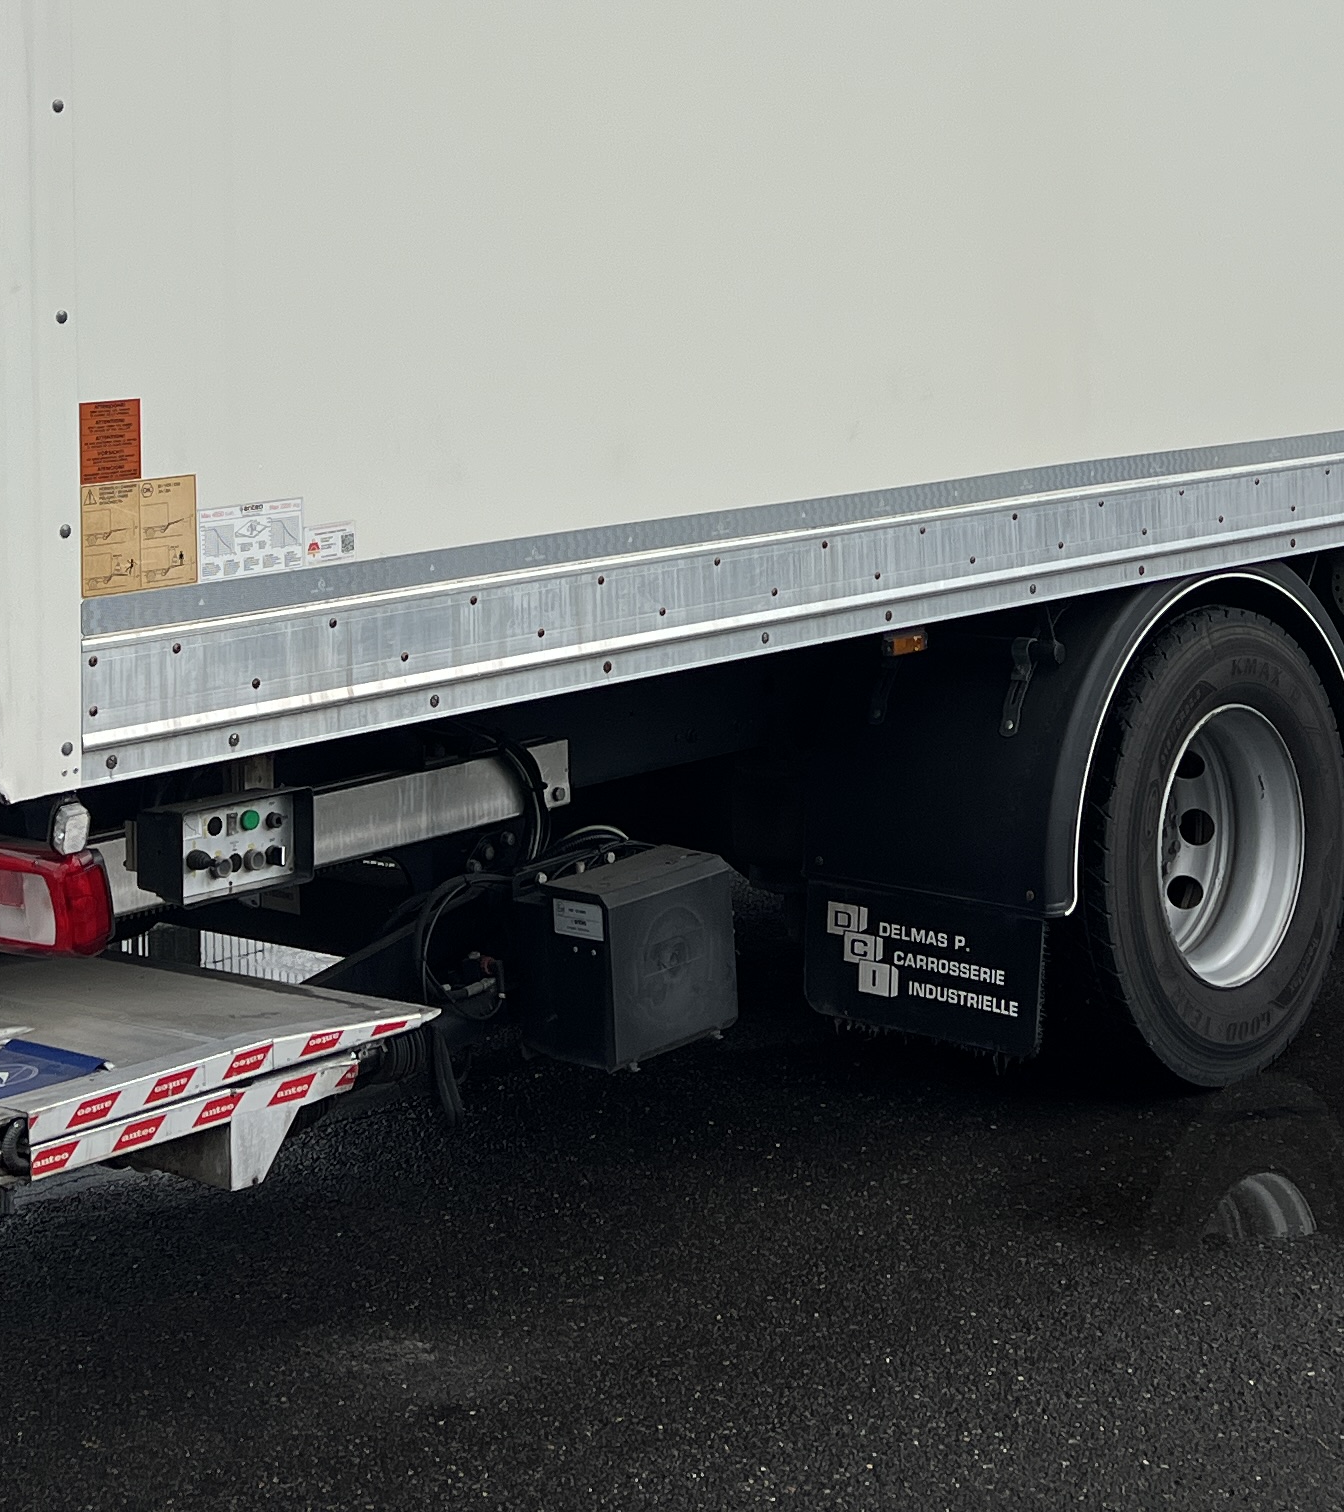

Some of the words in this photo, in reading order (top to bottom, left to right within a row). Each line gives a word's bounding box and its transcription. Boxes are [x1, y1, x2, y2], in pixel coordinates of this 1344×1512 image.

[879, 922, 948, 948] DELMAS
[954, 935, 971, 953] P.
[893, 950, 1006, 987] CARROSSERIE
[908, 981, 1019, 1017] INDUSTRIELLE
[276, 1083, 309, 1099] anteo
[201, 1102, 235, 1119] anteo
[121, 1125, 156, 1143] anteo
[32, 1151, 69, 1169] anteo
